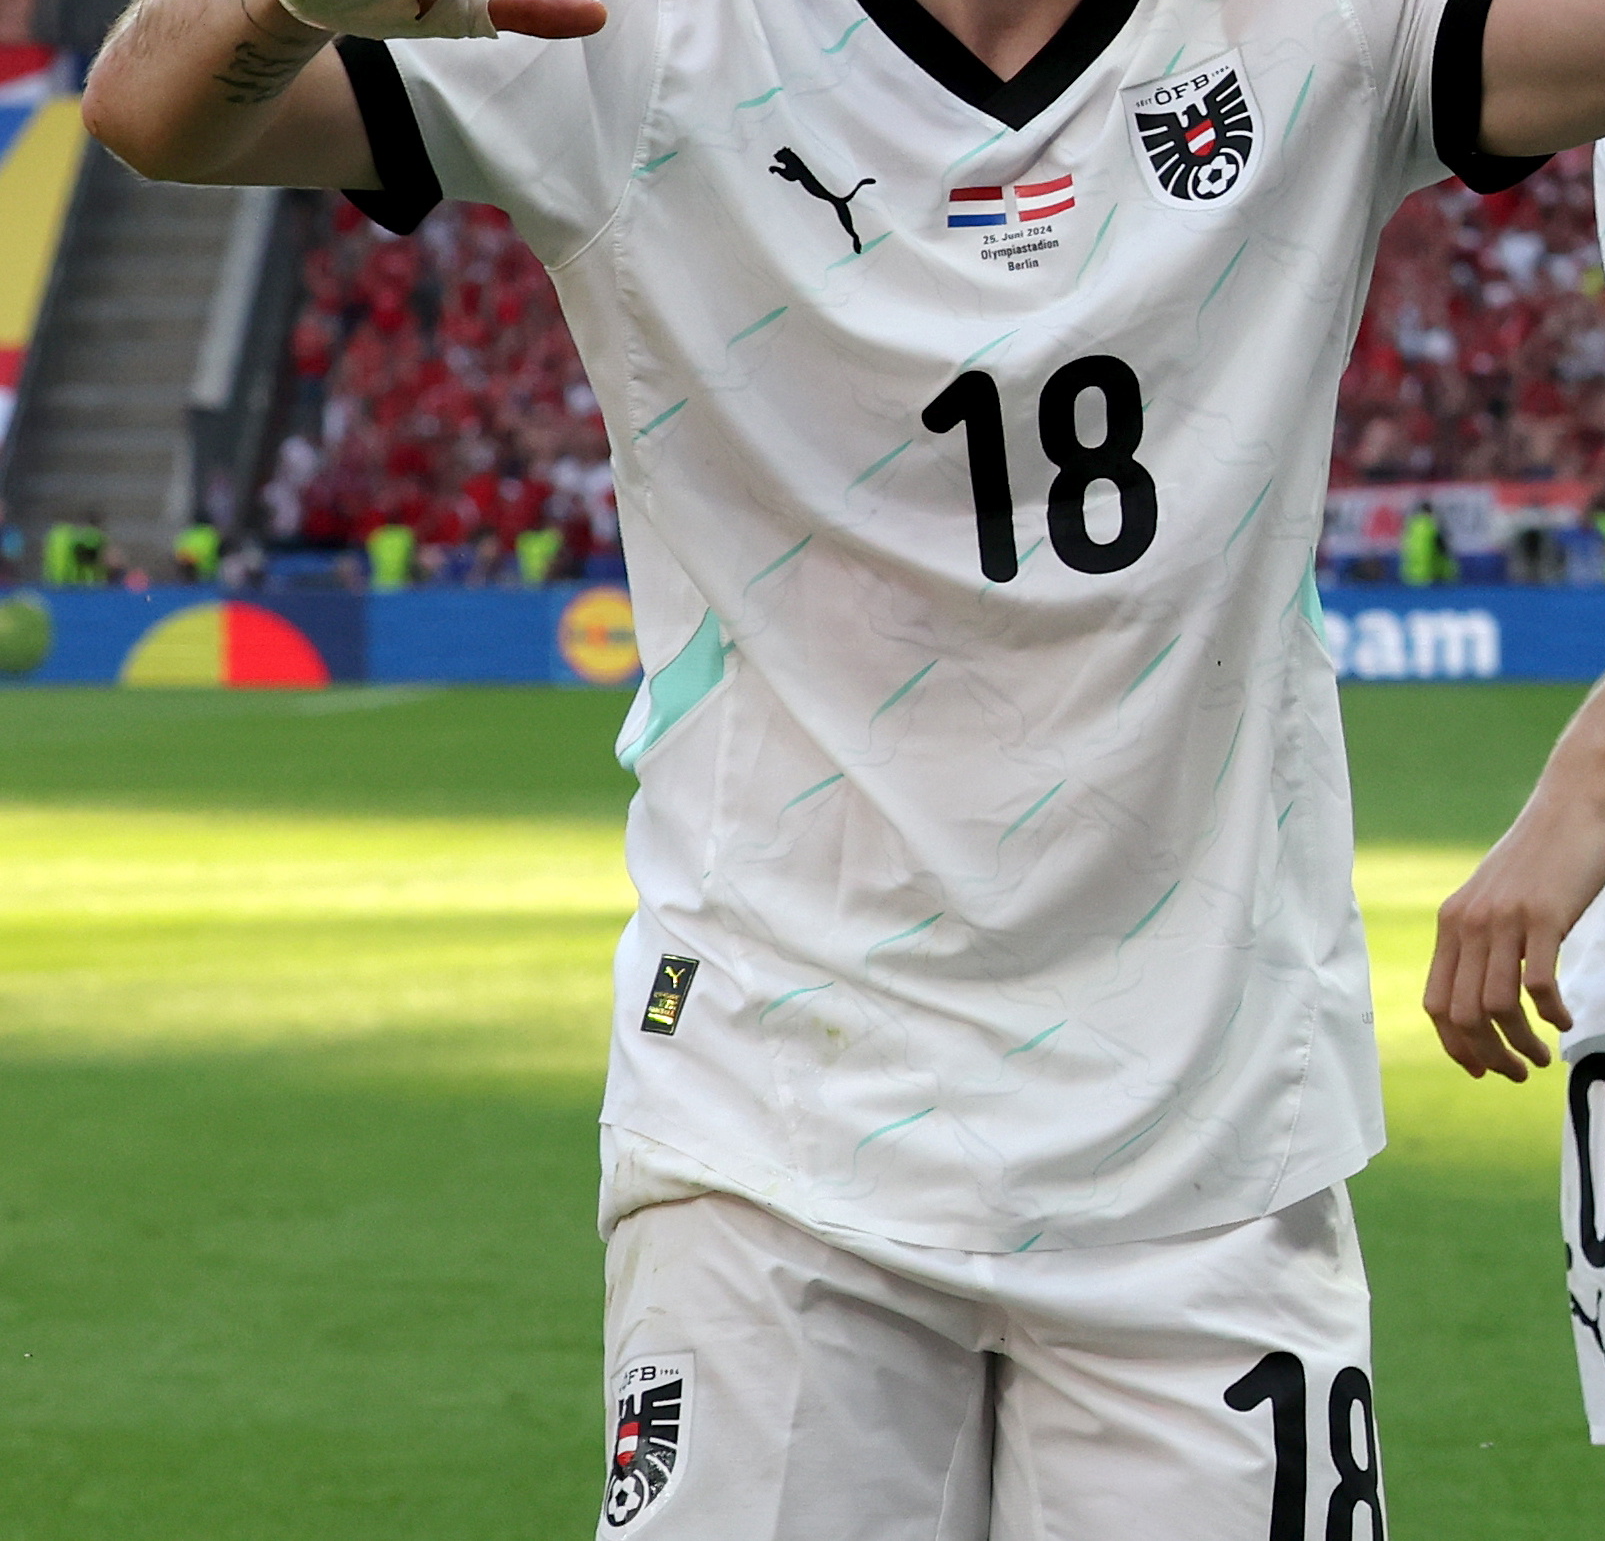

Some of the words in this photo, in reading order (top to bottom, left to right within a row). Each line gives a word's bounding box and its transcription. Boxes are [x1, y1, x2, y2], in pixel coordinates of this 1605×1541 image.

[1154, 73, 1210, 106] ÖFB
[980, 237, 1060, 260] Olympiastadion
[982, 235, 998, 245] 25.
[1002, 230, 1024, 241] Juni
[1027, 225, 1053, 237] 2024
[1007, 258, 1040, 271] Berlin
[921, 354, 1158, 583] 18
[1223, 1350, 1386, 1541] 18
